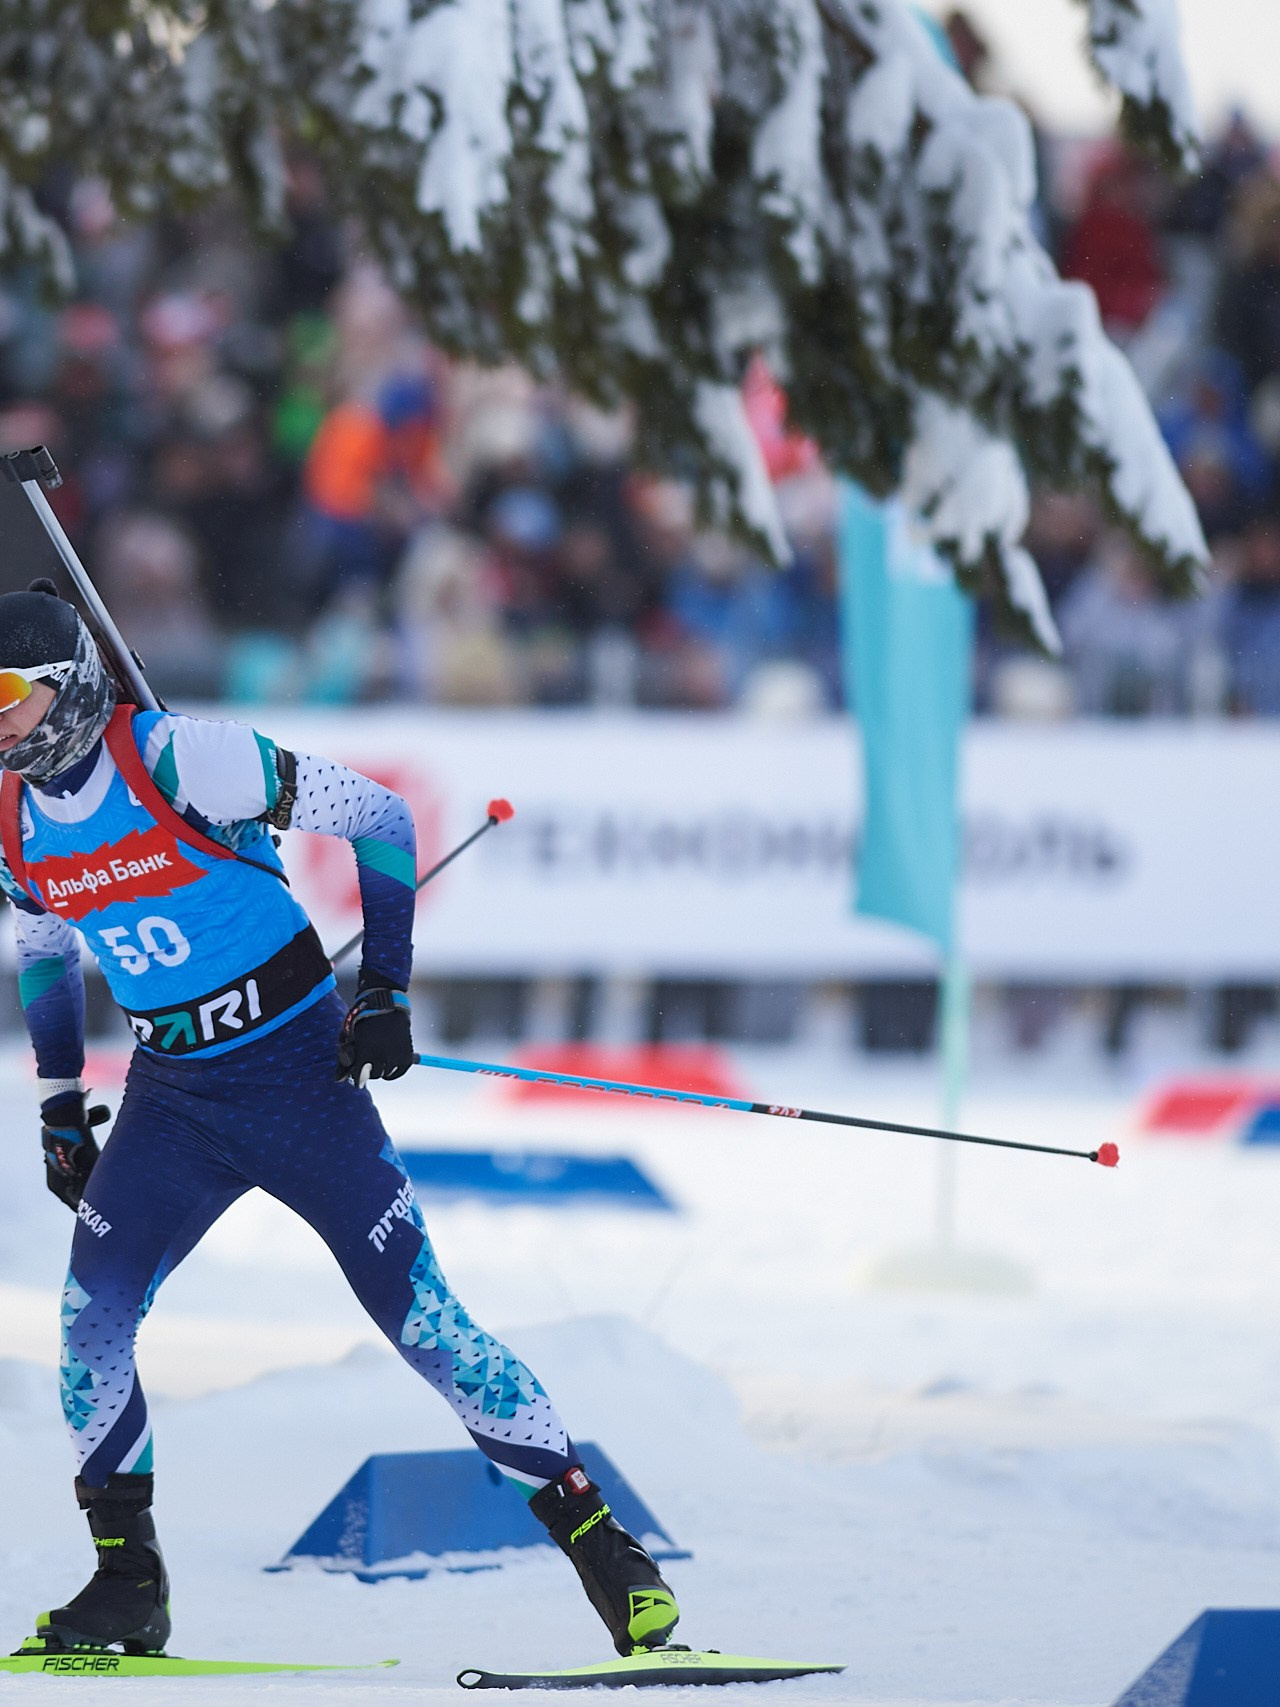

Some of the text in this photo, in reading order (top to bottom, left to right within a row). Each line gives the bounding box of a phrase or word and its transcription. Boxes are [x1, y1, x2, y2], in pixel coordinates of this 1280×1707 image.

[46, 851, 173, 900] Альфа Банк
[97, 915, 191, 976] 50
[42, 1657, 120, 1671] FISCHER
